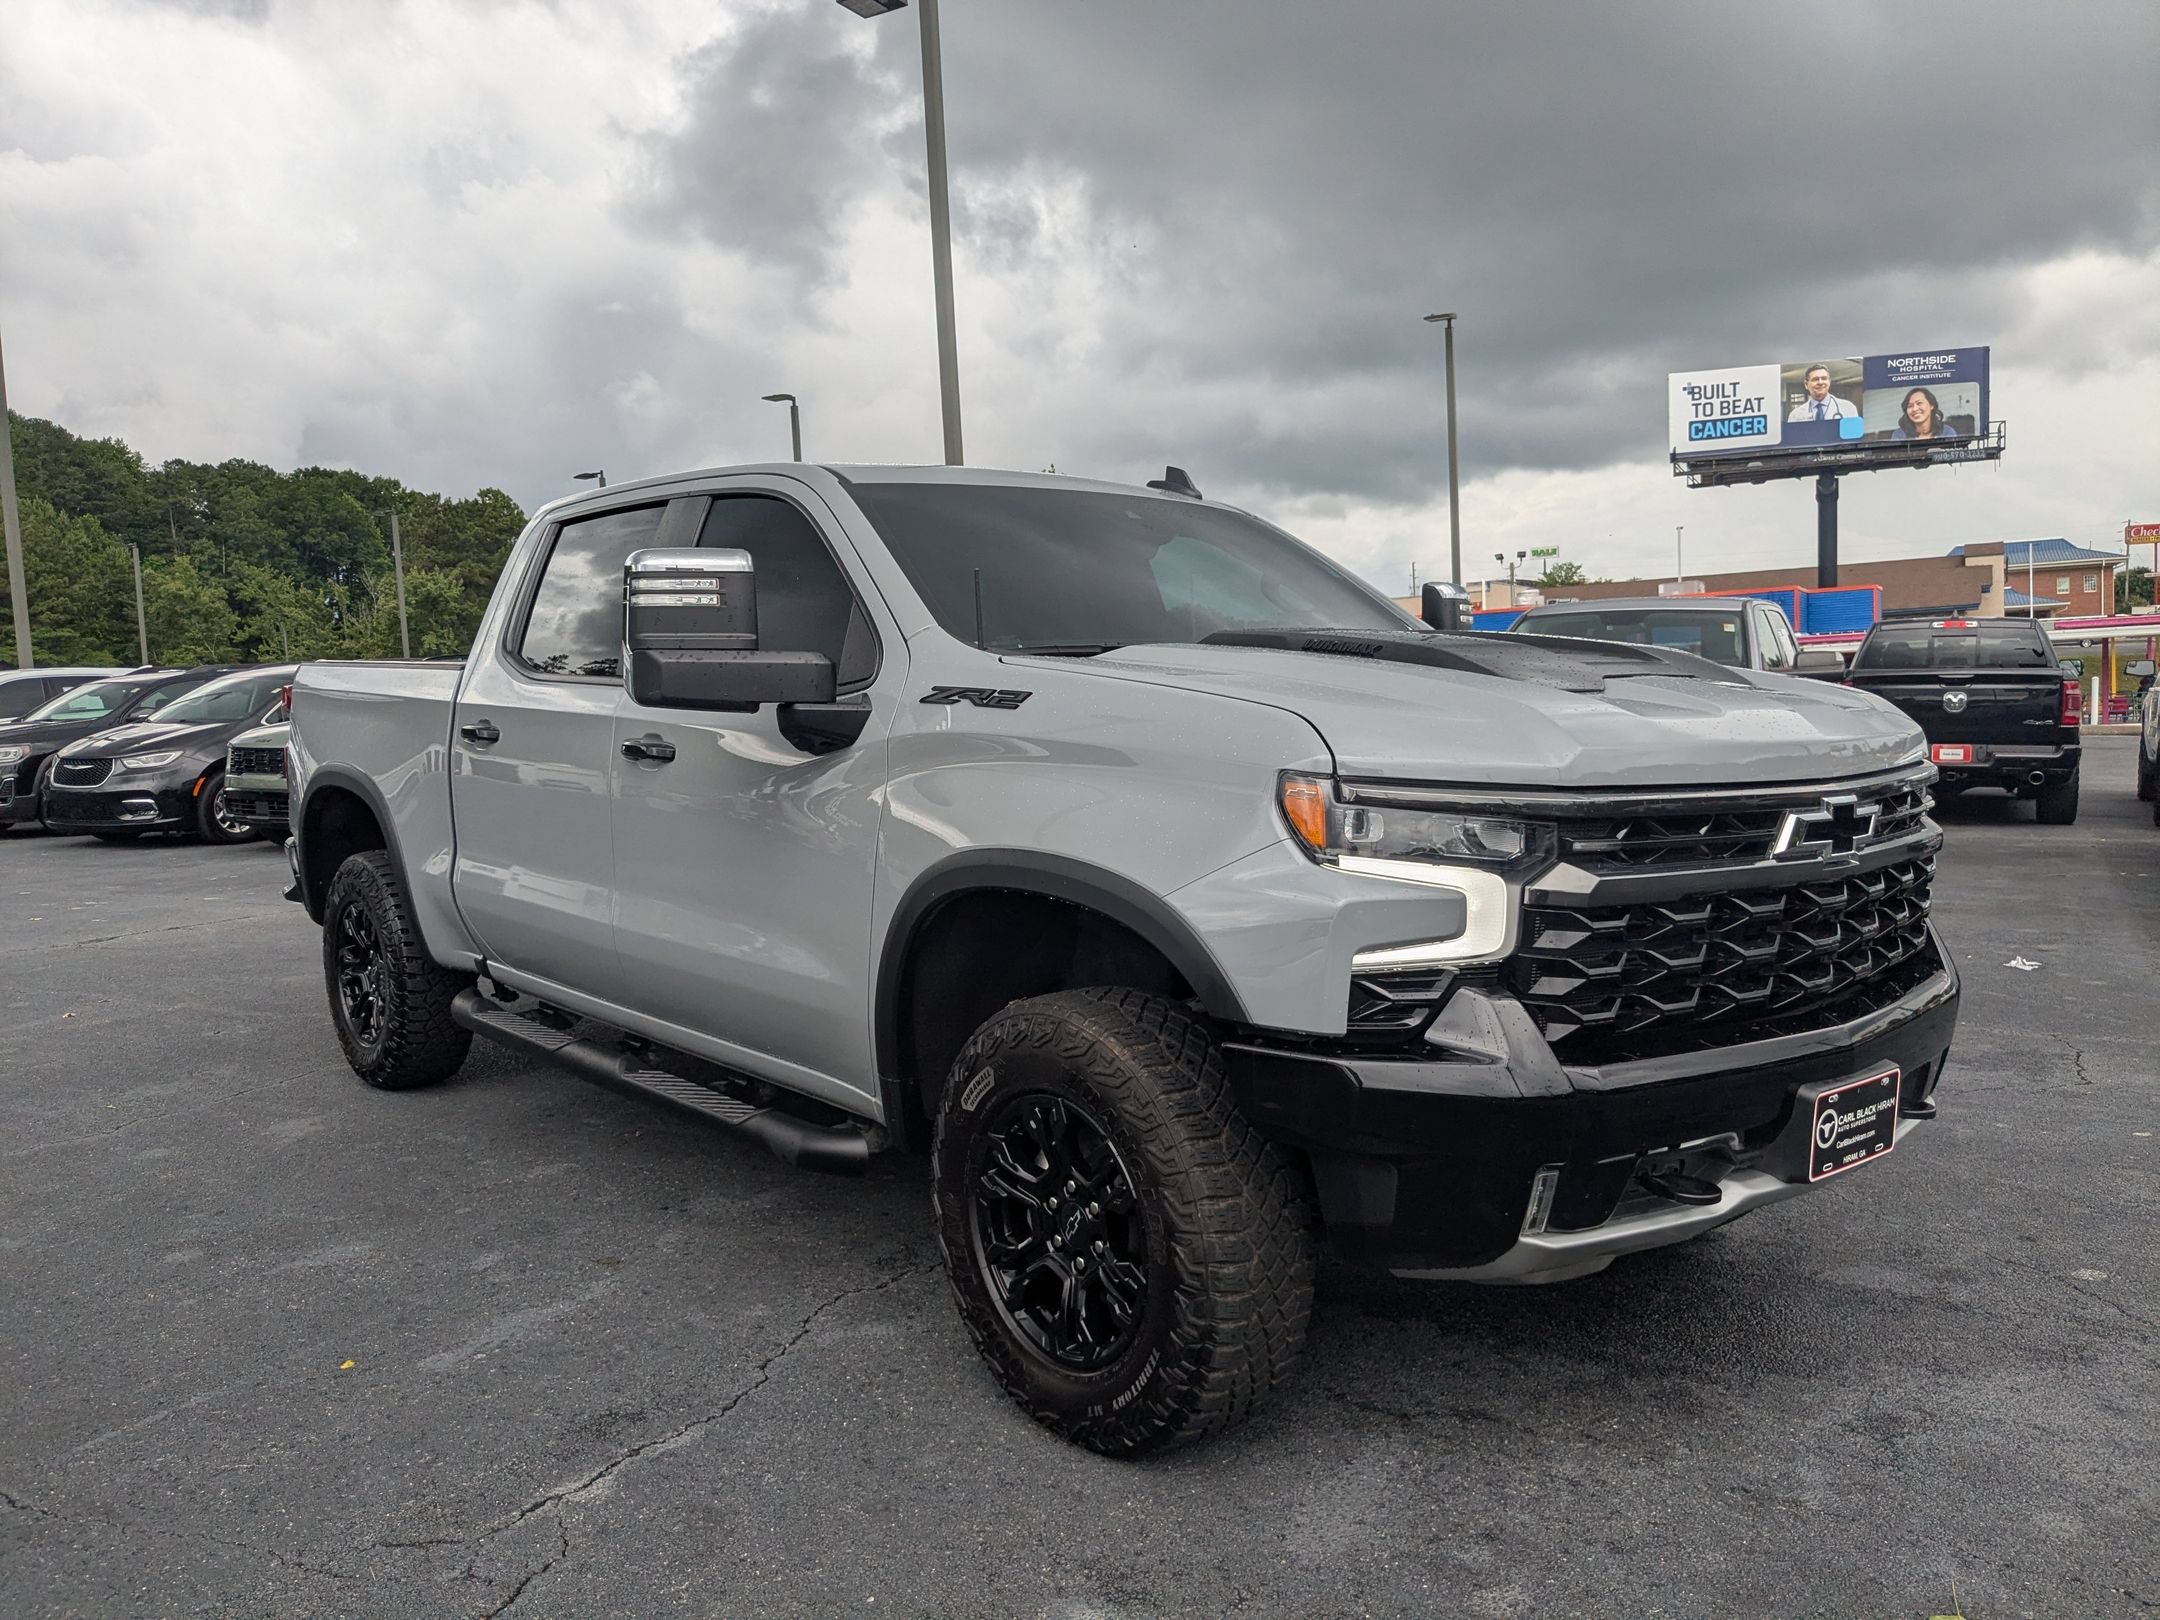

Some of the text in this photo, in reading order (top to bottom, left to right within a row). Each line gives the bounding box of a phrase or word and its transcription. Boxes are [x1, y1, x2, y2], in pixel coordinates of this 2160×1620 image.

[1887, 354, 1956, 368] NORTHSIDE
[1900, 364, 1944, 373] HOSPITAL
[1919, 372, 1951, 380] INSTITUTE
[1691, 382, 1740, 401] BUILT
[1691, 397, 1765, 418] TO BEAT
[1690, 417, 1766, 439] CANCER
[2130, 526, 2160, 538] Chec
[919, 686, 1033, 709] ZR2
[962, 1068, 991, 1106] DURAWALL
[1838, 1097, 1896, 1125] CARL BLACK HIRAM
[1838, 1114, 1876, 1132] AUTO SUPERSTORE
[1858, 1149, 1866, 1158] GA
[1112, 1347, 1160, 1411] TERRITORY
